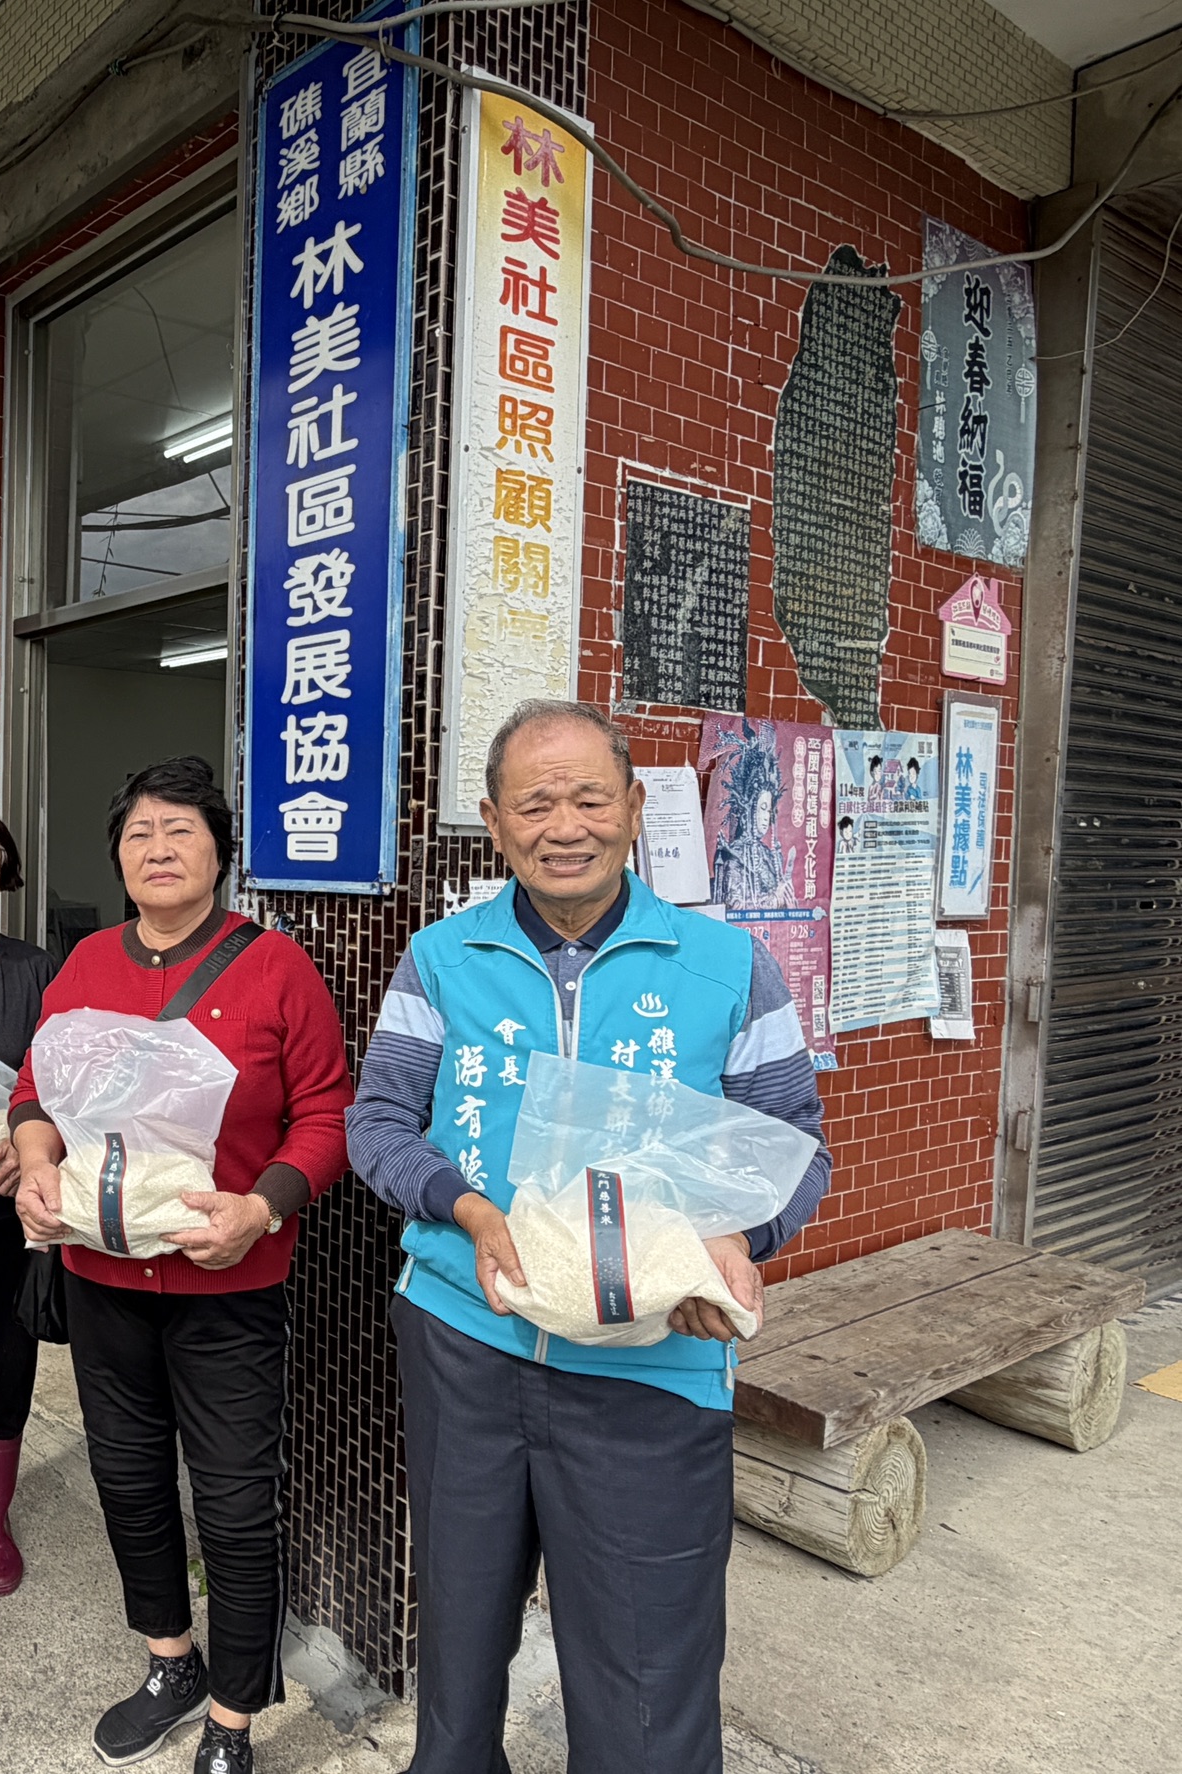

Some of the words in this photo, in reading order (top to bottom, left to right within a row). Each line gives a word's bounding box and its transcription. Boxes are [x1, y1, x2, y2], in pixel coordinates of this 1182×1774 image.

[276, 81, 323, 235] 礁溪鄉
[337, 46, 387, 200] 宜蘭縣
[957, 271, 994, 523] 迎春納福
[278, 219, 364, 862] 林美社區發展協會
[949, 746, 973, 889] 林美據點
[205, 934, 248, 974] JIELSHI
[493, 1018, 527, 1087] 會長
